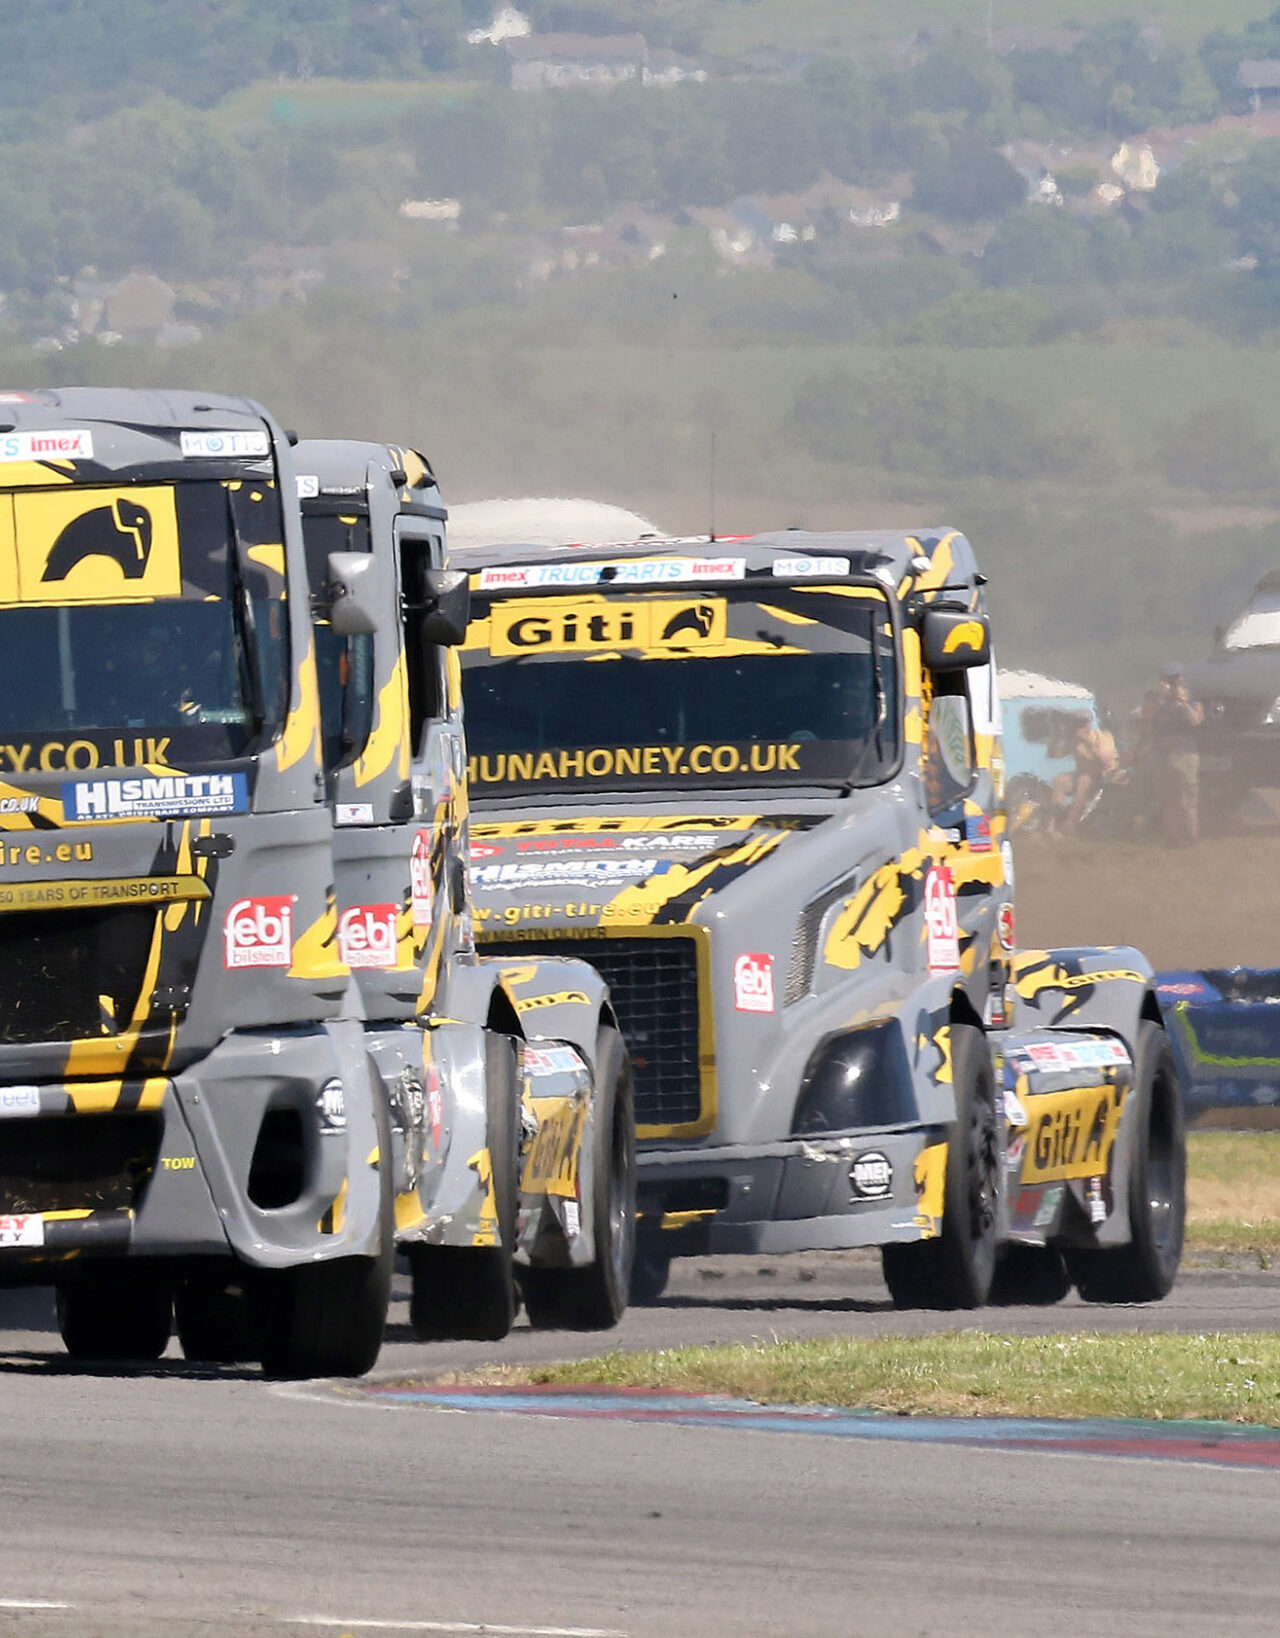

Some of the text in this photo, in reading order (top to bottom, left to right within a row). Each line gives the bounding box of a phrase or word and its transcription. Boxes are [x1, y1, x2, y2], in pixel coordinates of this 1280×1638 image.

[31, 434, 81, 453] imex
[485, 571, 527, 584] imex
[692, 560, 734, 575] imex
[507, 613, 634, 647] Giti
[0, 891, 13, 903] 50
[70, 886, 88, 899] OF
[93, 882, 179, 898] TRANSPORT
[224, 901, 291, 948] febi
[337, 908, 397, 954] febi
[232, 950, 286, 964] bilstein
[735, 956, 771, 996] febi
[162, 1157, 194, 1170] TOW
